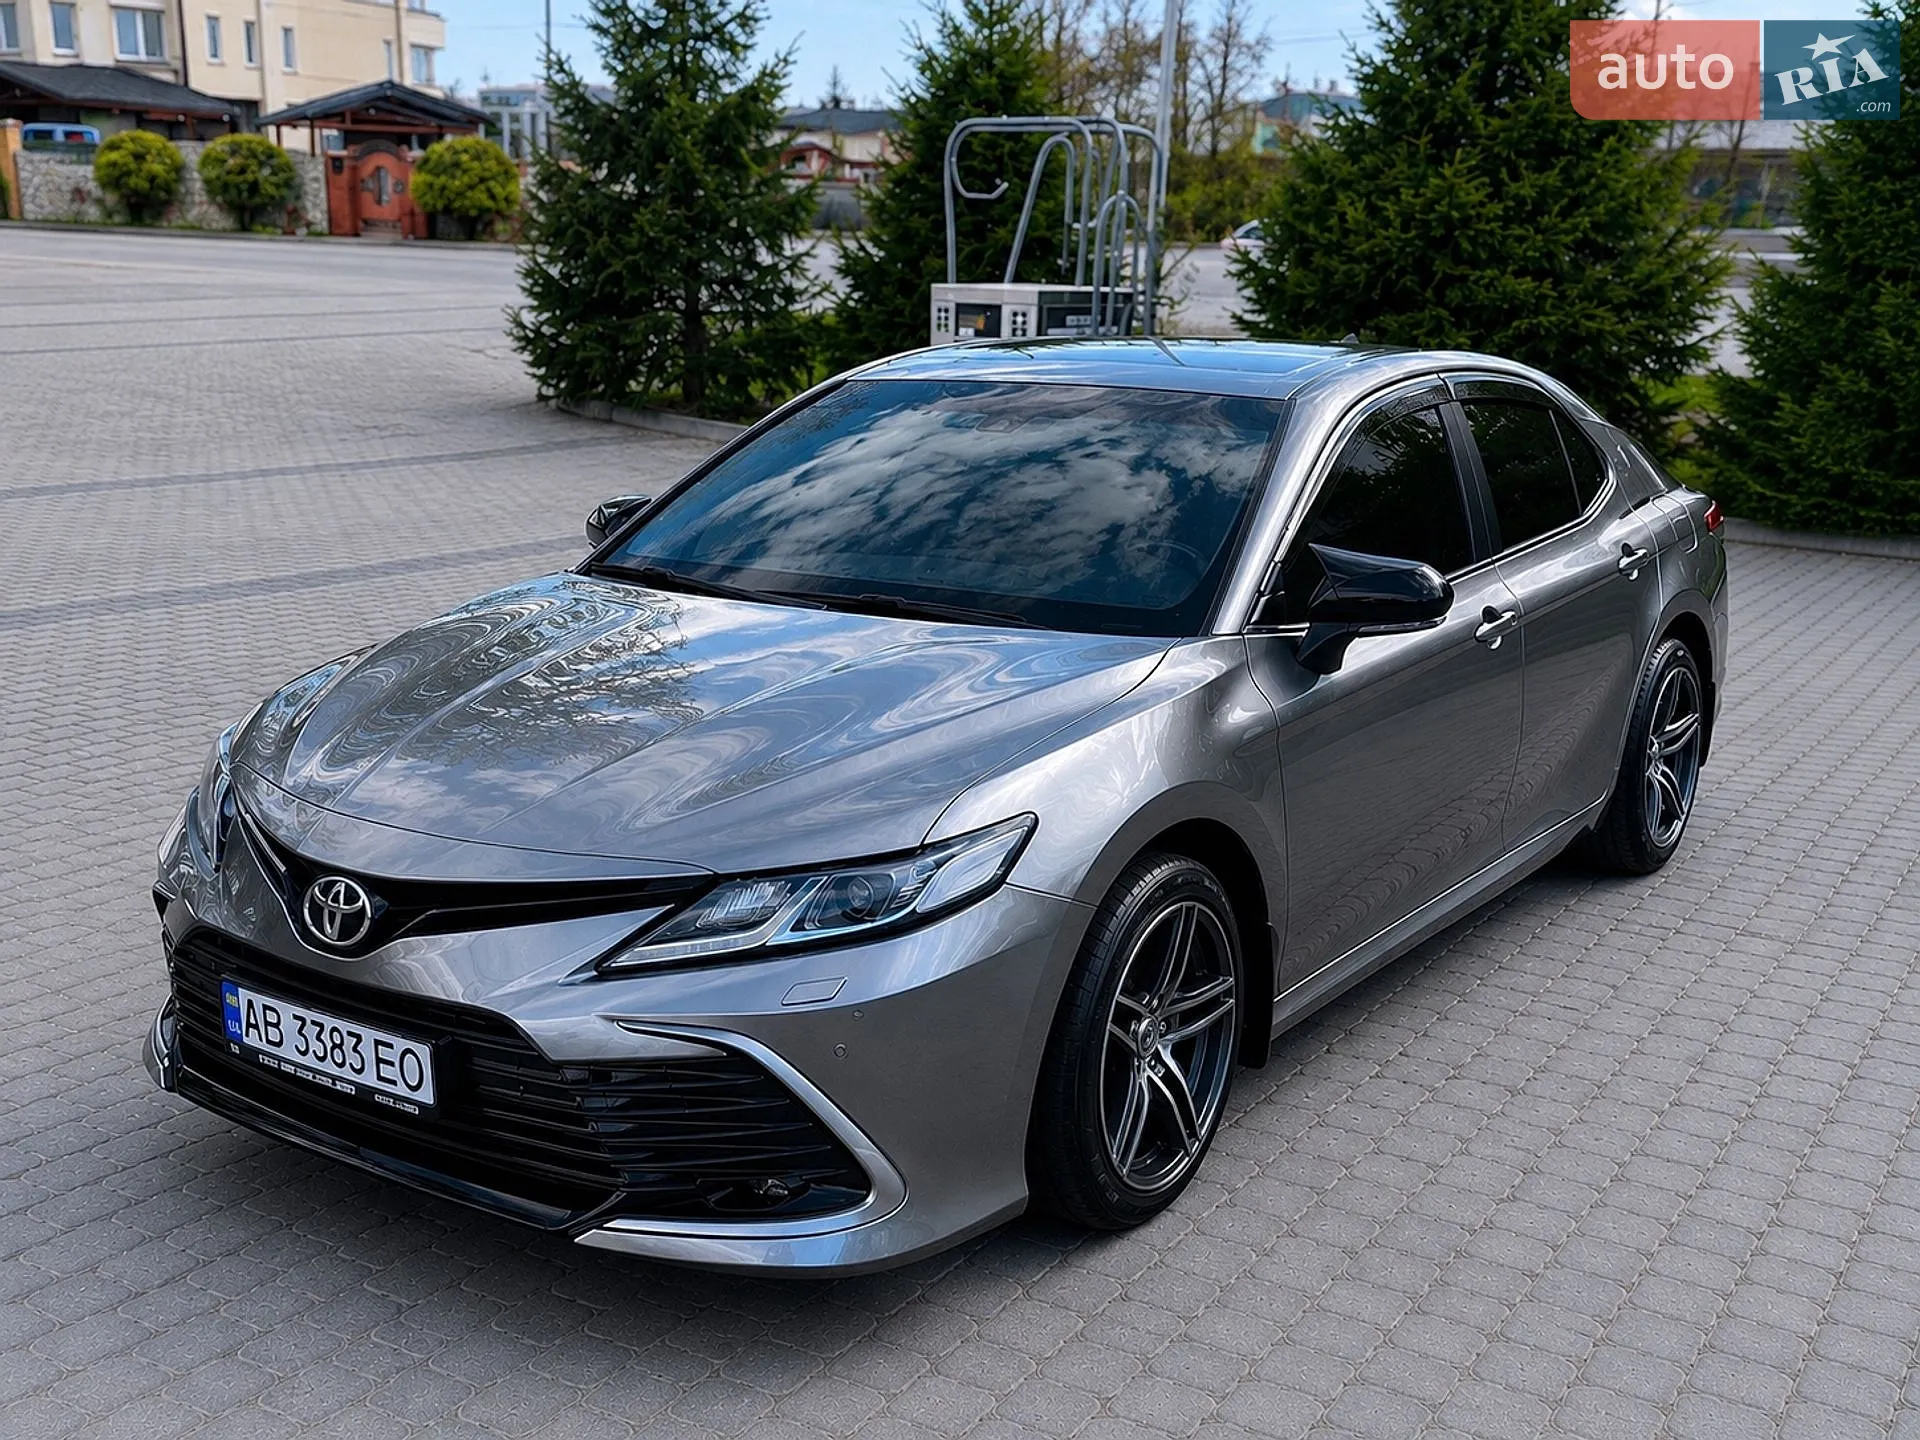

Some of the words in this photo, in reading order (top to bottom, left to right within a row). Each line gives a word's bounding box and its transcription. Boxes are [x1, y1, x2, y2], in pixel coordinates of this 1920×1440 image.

[245, 998, 284, 1049] AB
[291, 1013, 366, 1076] 3383
[373, 1038, 424, 1092] EO
